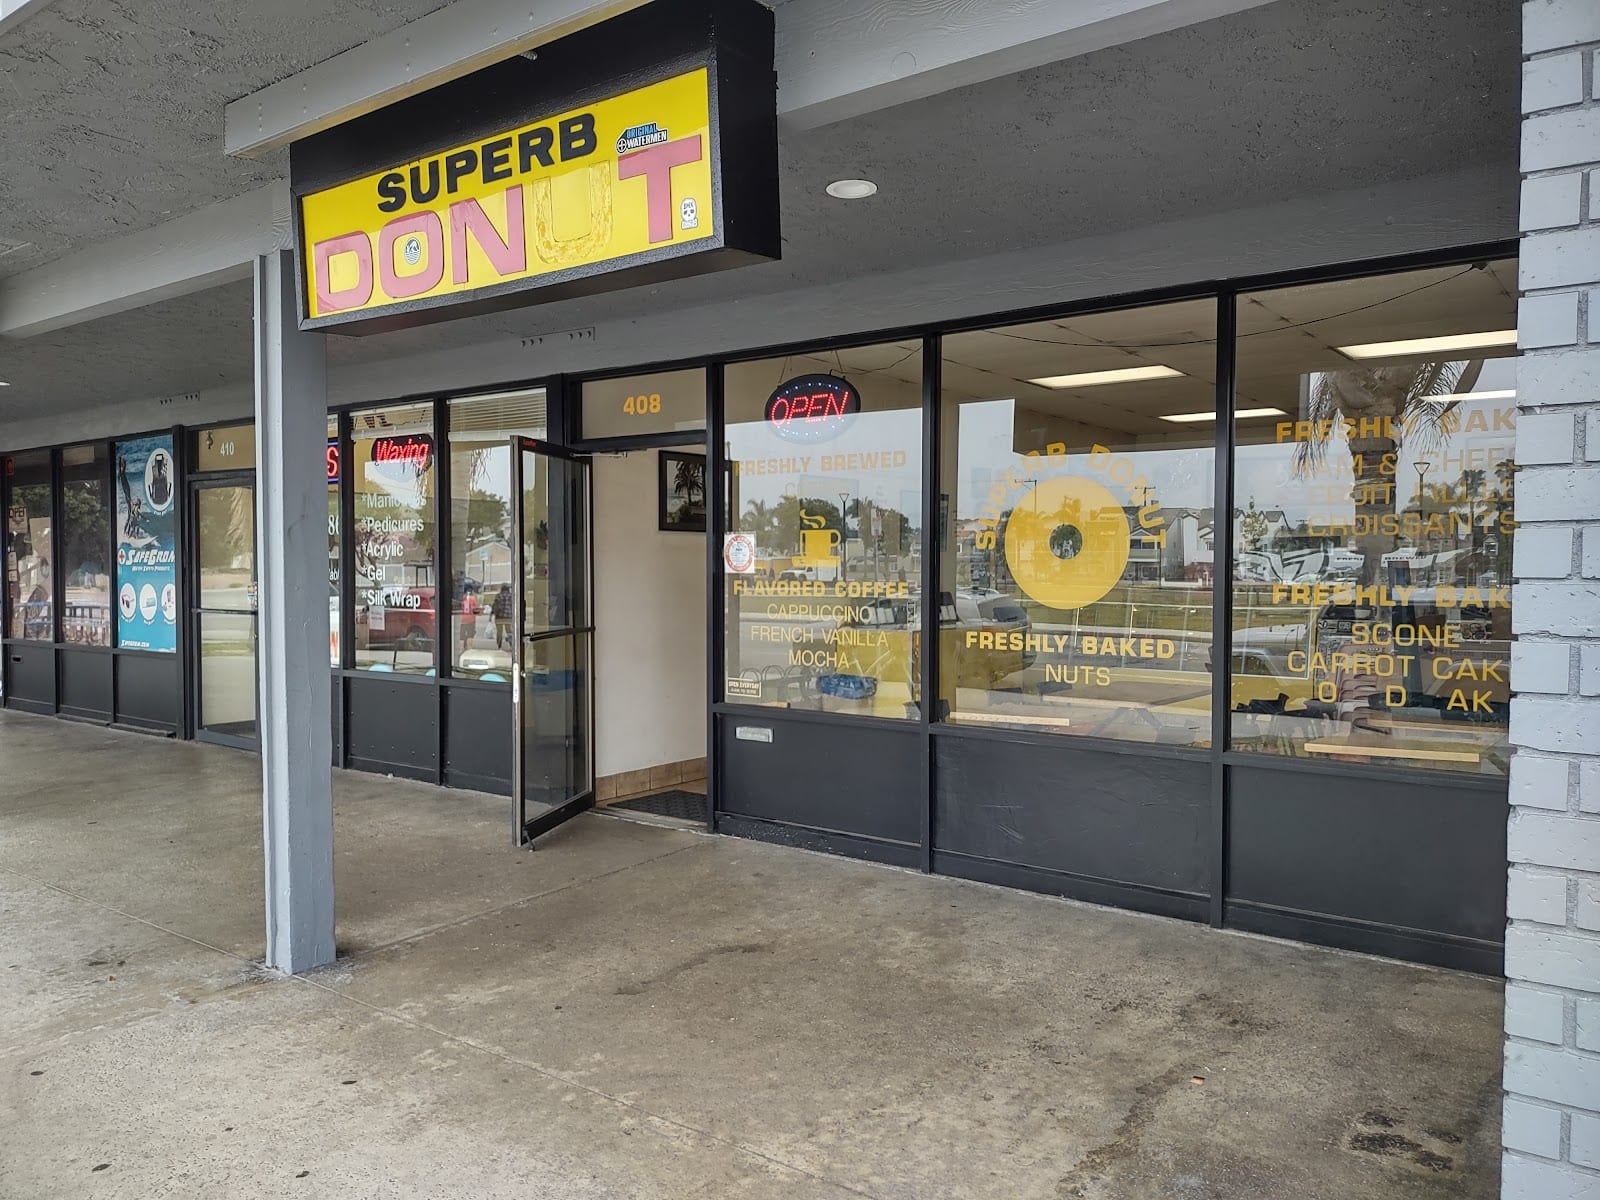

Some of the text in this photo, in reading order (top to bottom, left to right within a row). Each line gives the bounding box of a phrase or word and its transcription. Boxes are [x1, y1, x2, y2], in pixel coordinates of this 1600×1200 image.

[626, 123, 657, 139] ORIGINAL
[626, 130, 667, 149] WATERMEN
[377, 113, 598, 213] SUPERB
[314, 134, 702, 314] DONUT
[623, 394, 661, 415] 408
[771, 391, 849, 427] OPEN
[220, 443, 235, 457] 410
[376, 439, 430, 468] Waxing
[736, 450, 906, 477] FRESHLY BREWED
[1380, 453, 1398, 475] &
[1308, 511, 1520, 538] CROISSANTS
[389, 591, 421, 609] Wrap
[733, 579, 909, 599] FLAVORED COFFEE
[1272, 584, 1417, 607] FRESHLY
[767, 603, 873, 624] CAPPUCCINO
[751, 625, 889, 648] FRENCH VANILLA
[966, 631, 1175, 659] FRESHLY BAKED
[1351, 622, 1461, 649] SCONE
[788, 649, 850, 669] MOCHA
[1287, 650, 1415, 678] CARROT
[1045, 663, 1111, 687] NUTS
